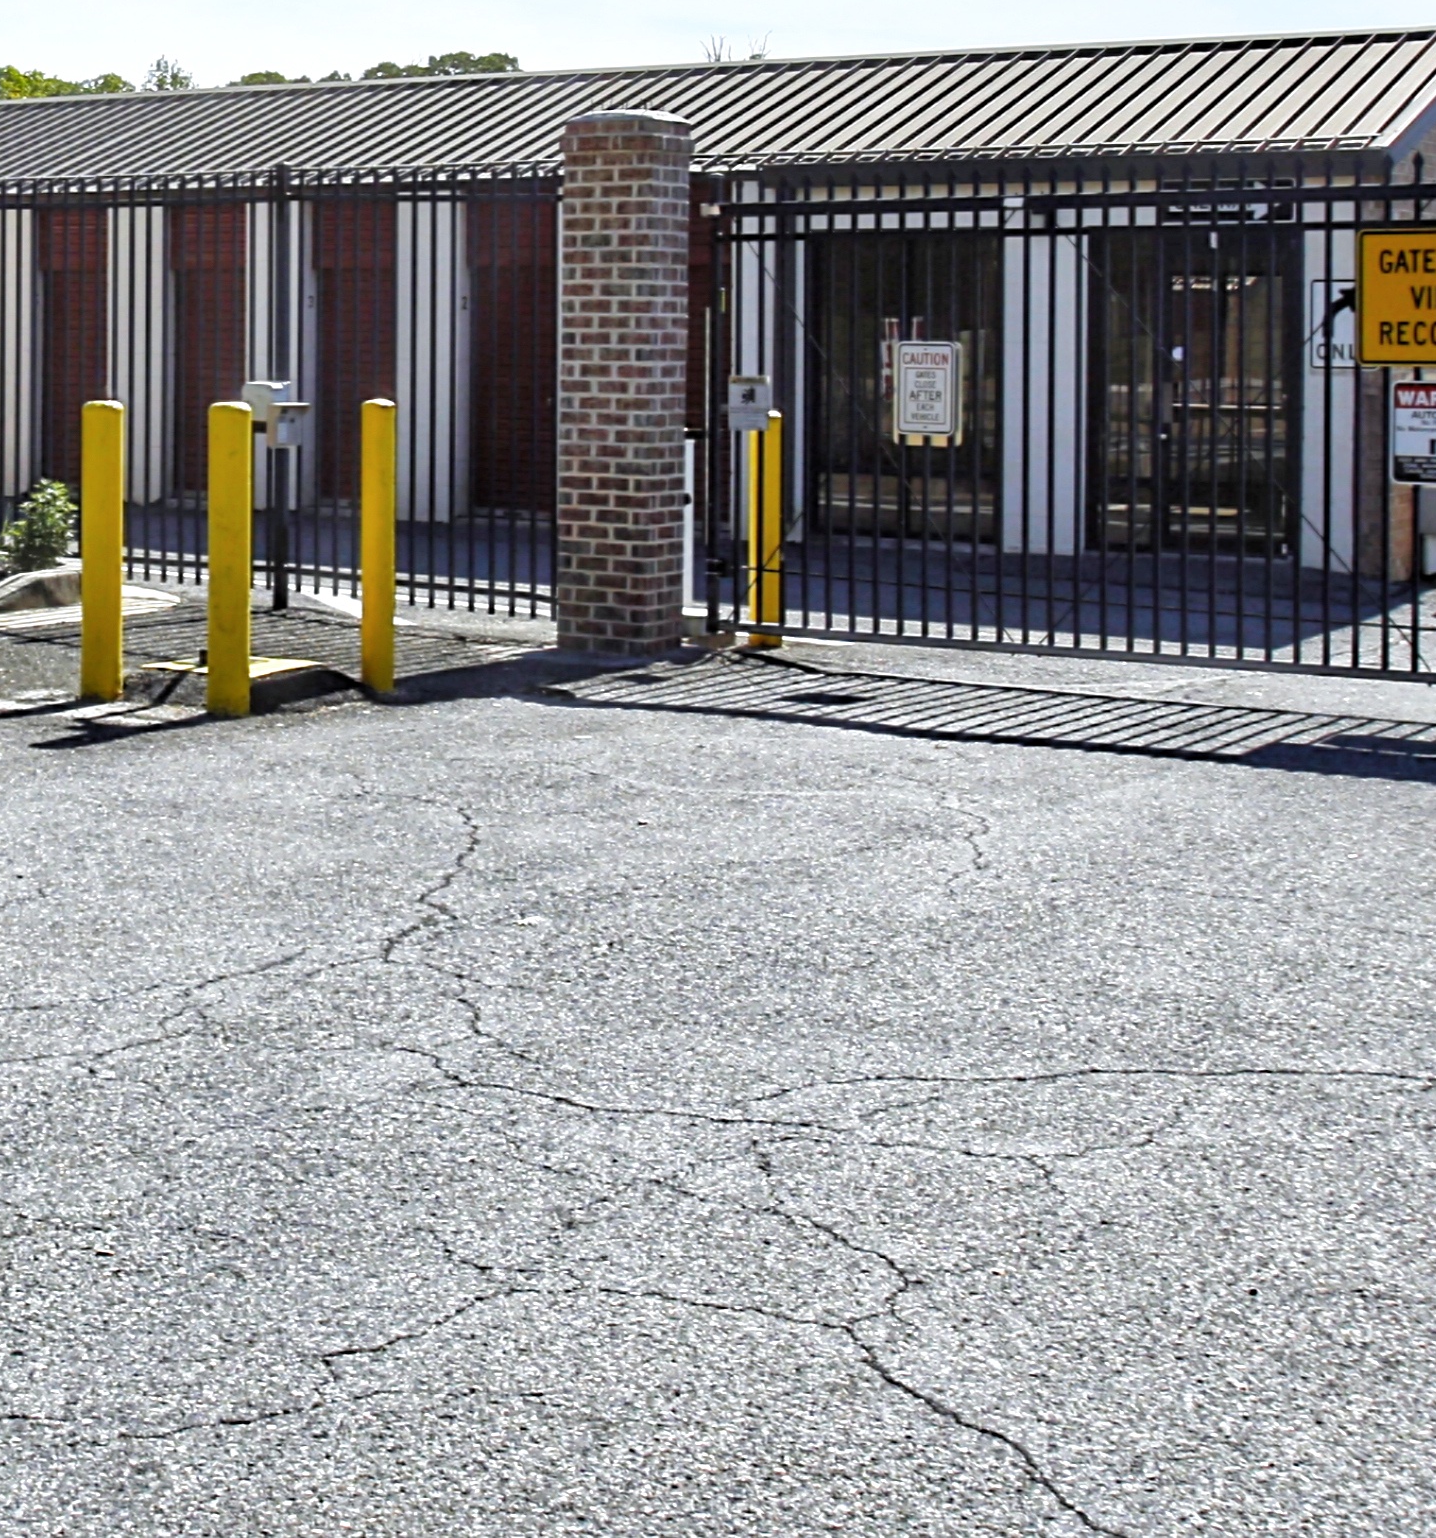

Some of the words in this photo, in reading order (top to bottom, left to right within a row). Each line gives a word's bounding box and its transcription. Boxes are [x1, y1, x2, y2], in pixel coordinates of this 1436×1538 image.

[1379, 249, 1436, 274] GATE
[902, 352, 950, 366] CAUTION
[909, 390, 942, 401] AFTER
